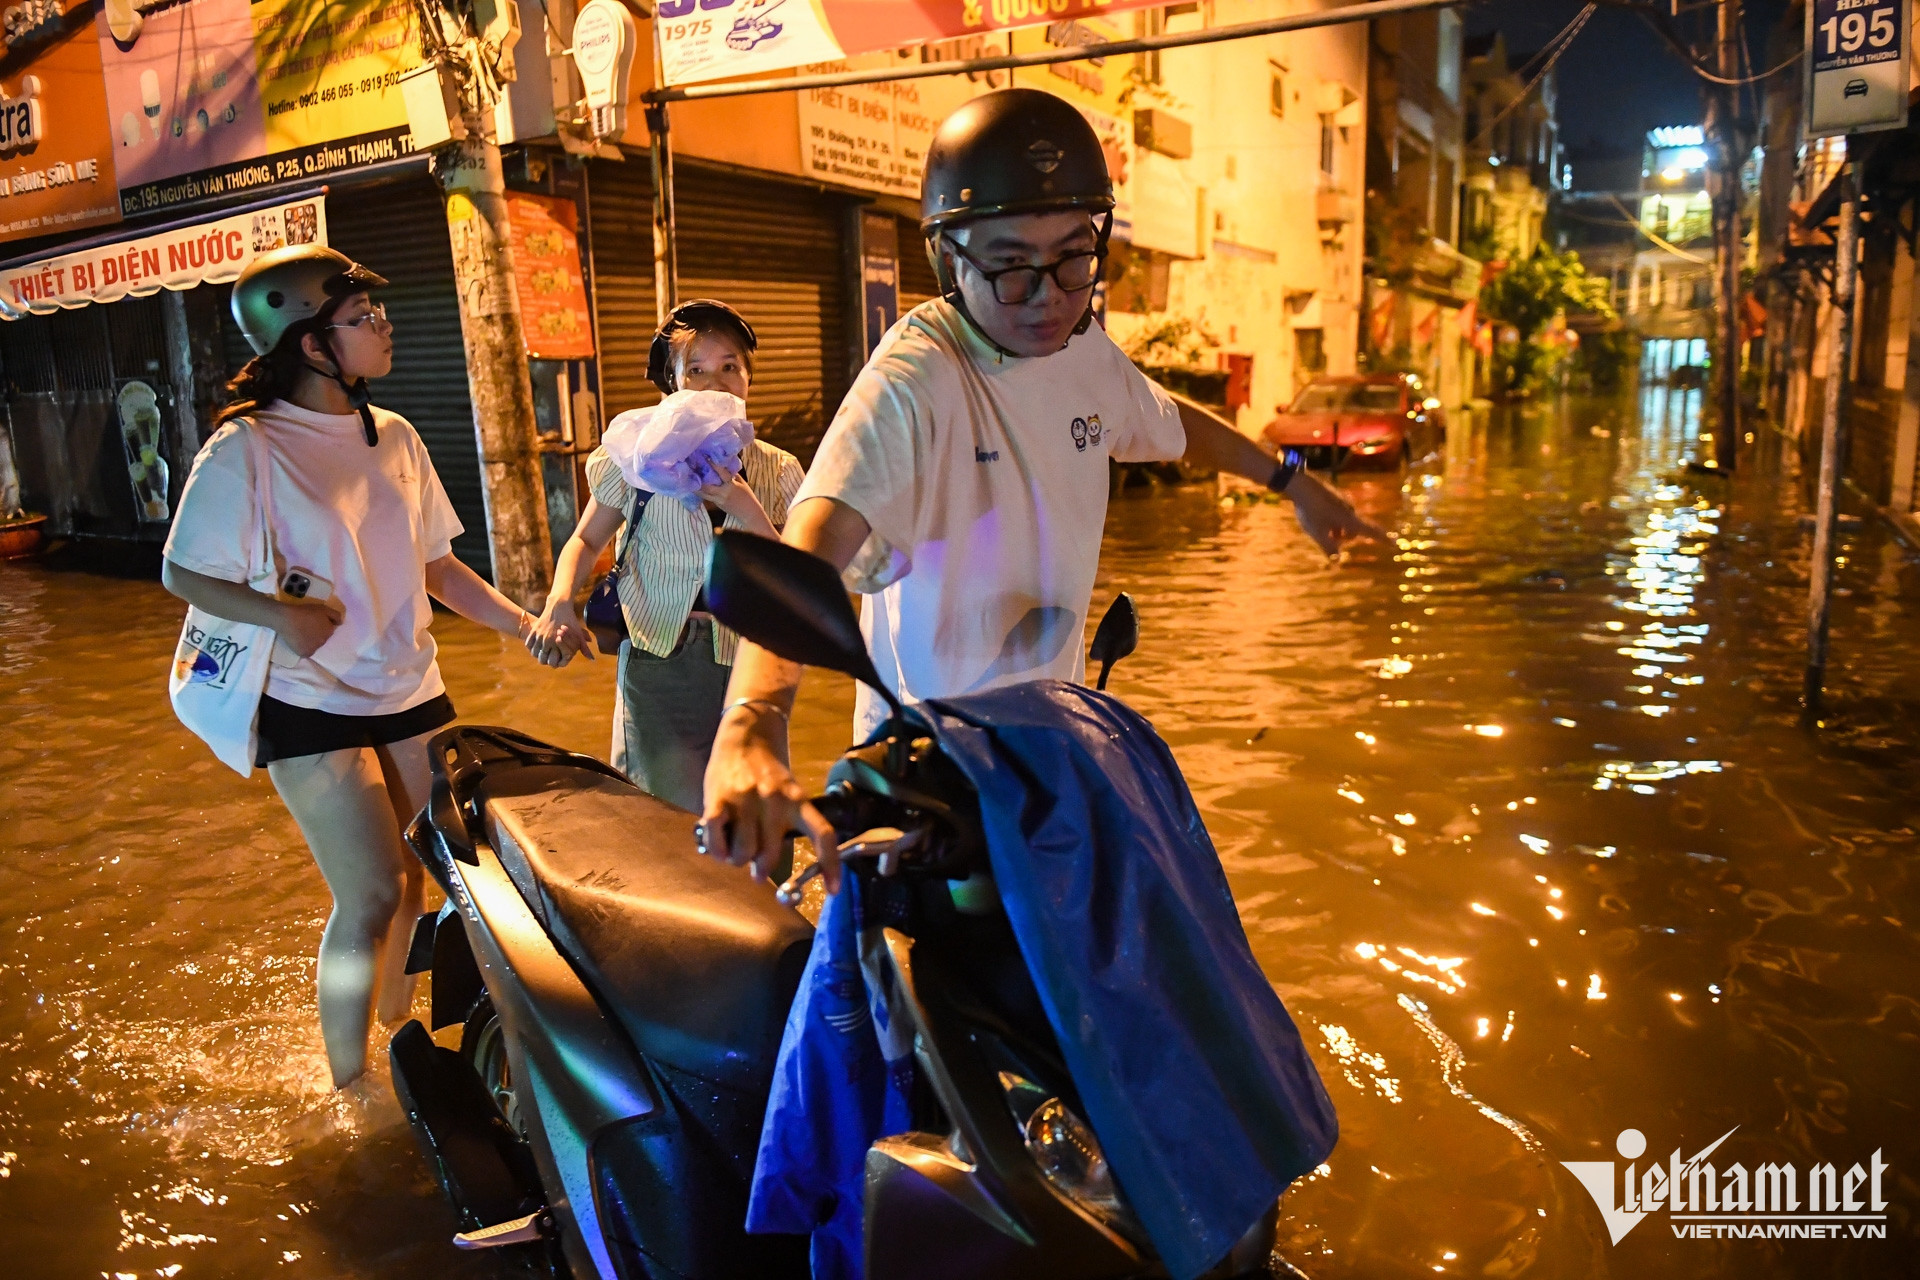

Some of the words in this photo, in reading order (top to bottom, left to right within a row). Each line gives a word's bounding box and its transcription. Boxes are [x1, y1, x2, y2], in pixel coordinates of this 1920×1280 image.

[664, 18, 713, 42] 1975
[1820, 7, 1895, 54] 195
[1848, 54, 1865, 66] VĂN
[268, 100, 298, 117] Hotline:
[299, 91, 318, 109] 0902
[321, 87, 336, 103] 466
[338, 83, 354, 100] 055
[361, 77, 382, 93] 0919
[384, 70, 400, 90] 502
[160, 176, 200, 204] NGUYỄN
[202, 174, 224, 195] VĂN
[348, 137, 398, 165] THẠNH,
[9, 262, 65, 304] THIẾT
[73, 261, 97, 297] BỊ
[102, 245, 162, 287] ĐIỆN
[168, 225, 244, 273] NƯỚC
